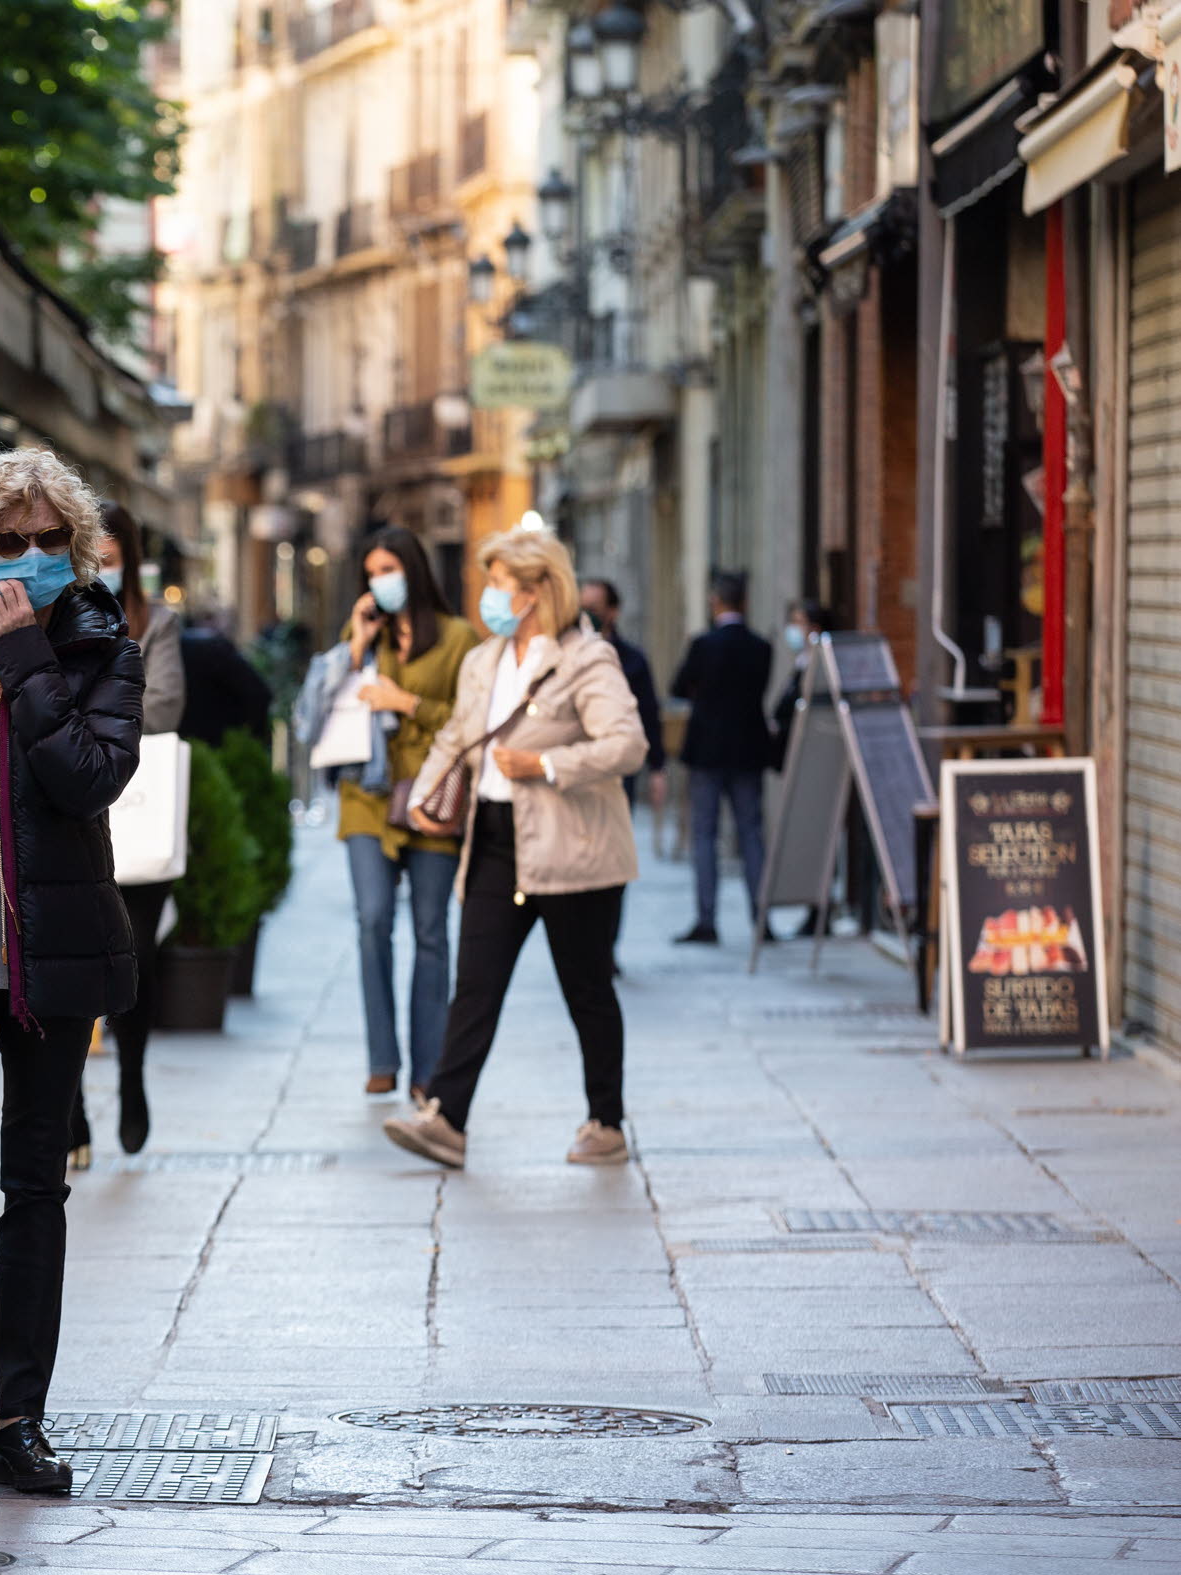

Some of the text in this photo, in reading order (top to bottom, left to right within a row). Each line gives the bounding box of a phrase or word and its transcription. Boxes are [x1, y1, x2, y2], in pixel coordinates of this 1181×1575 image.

[988, 821, 1053, 842] TAPAS
[968, 842, 1076, 865] SELECTION
[984, 976, 1075, 999] SURTIDO
[982, 999, 1078, 1022] DE TAPAS
